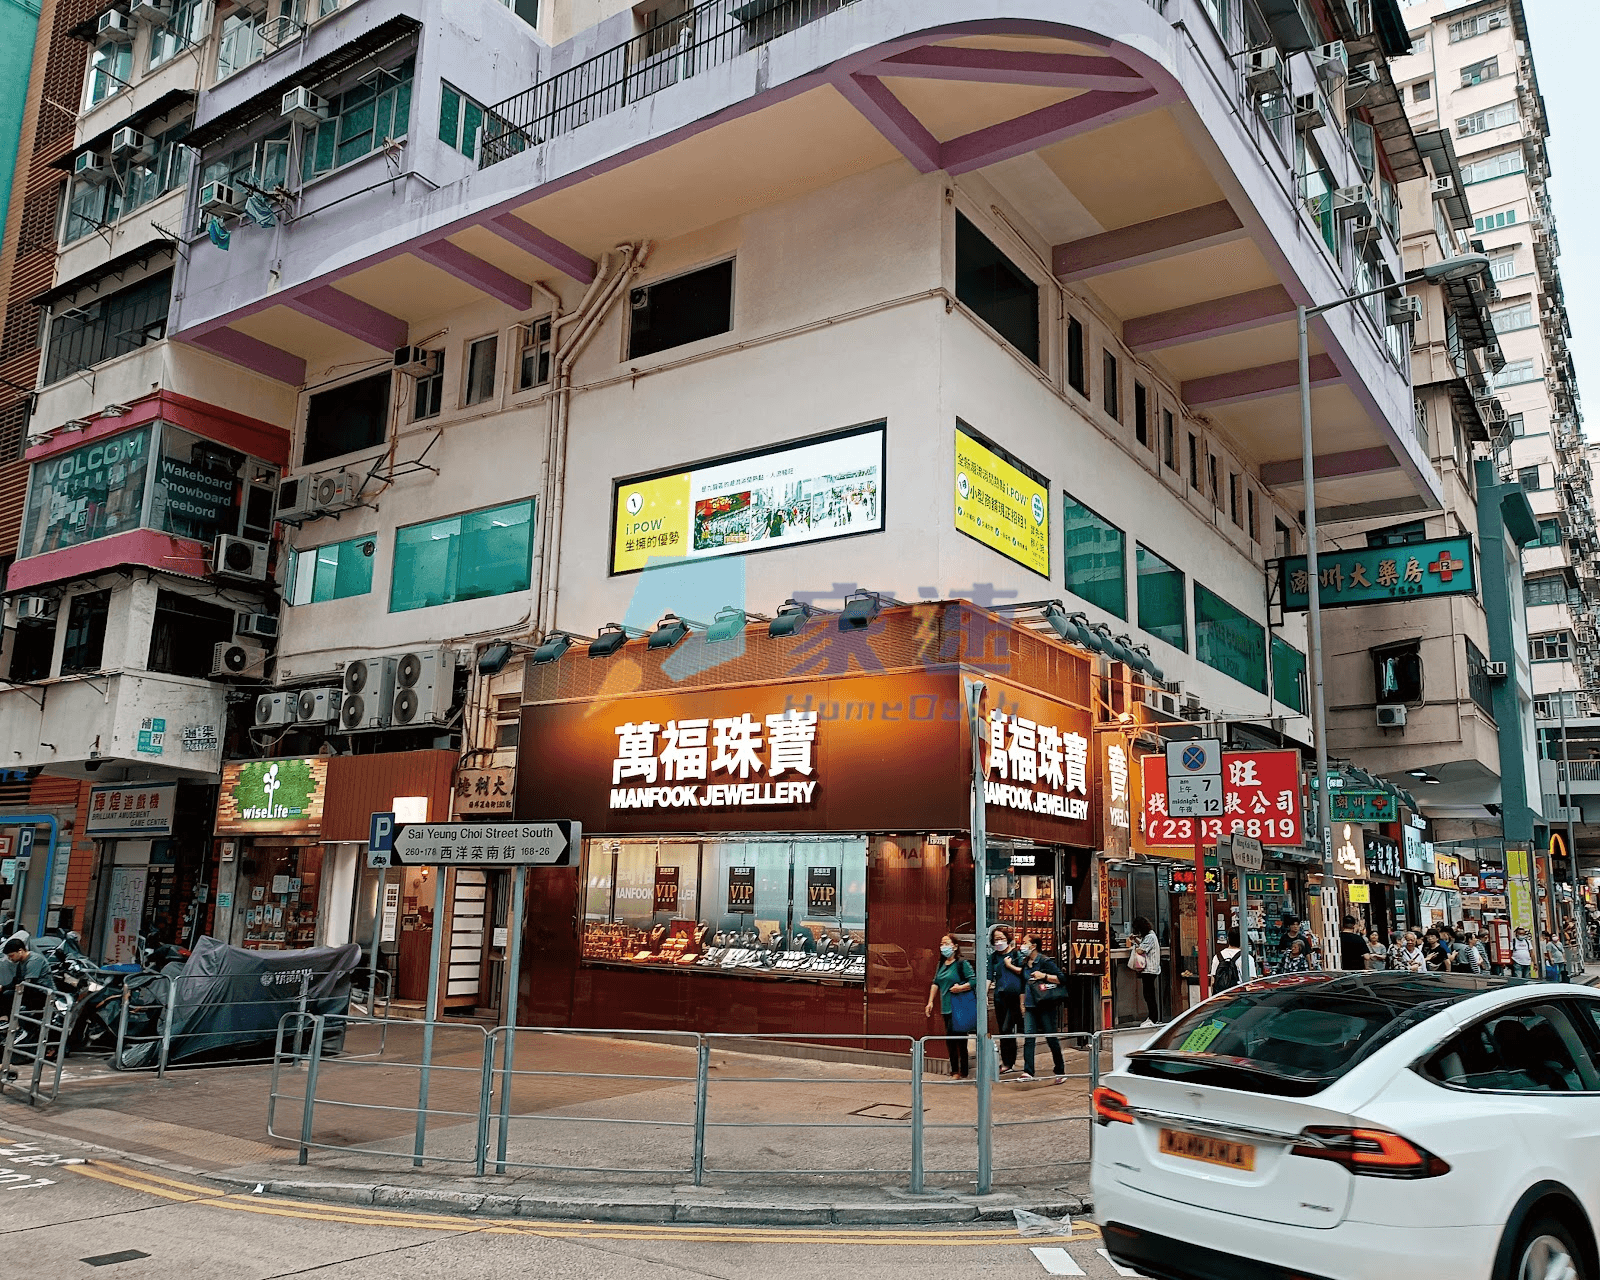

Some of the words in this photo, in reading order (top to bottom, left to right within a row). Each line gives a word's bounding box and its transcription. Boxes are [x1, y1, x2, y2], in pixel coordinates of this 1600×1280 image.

[46, 431, 144, 484] VOLCOM
[161, 459, 233, 492] Wakeboard
[160, 477, 232, 507] Snowboard
[626, 517, 664, 535] i.POW
[625, 531, 680, 552] 坐擁的優勢
[612, 709, 818, 785] 萬福珠寶
[989, 708, 1088, 796] 萬福珠寶
[609, 785, 700, 809] MANFOOK
[700, 781, 816, 806] JEWELLERY
[1202, 780, 1211, 792] 7
[93, 791, 160, 811] 輝煌遊戲機
[1033, 791, 1089, 821] JEWELLERY
[1203, 799, 1220, 812] 12
[91, 811, 118, 821] BRILLIANT
[118, 810, 150, 819] AMUSEMENT
[242, 803, 289, 819] wiseLife
[130, 819, 145, 827] GAME
[147, 817, 168, 826] CENTRE
[374, 817, 392, 848] P
[408, 828, 424, 839] Sai
[427, 828, 457, 841] Yeung
[460, 828, 483, 839] Choi
[485, 827, 519, 839] Street
[522, 827, 554, 838] South
[19, 831, 32, 855] P
[405, 848, 437, 856] 260-178
[440, 845, 516, 860] 西洋菜南街
[521, 847, 550, 856] 168-26
[655, 884, 678, 898] VIP
[730, 885, 753, 899] VIP
[809, 886, 835, 901] VIP
[1071, 942, 1105, 959] VIP
